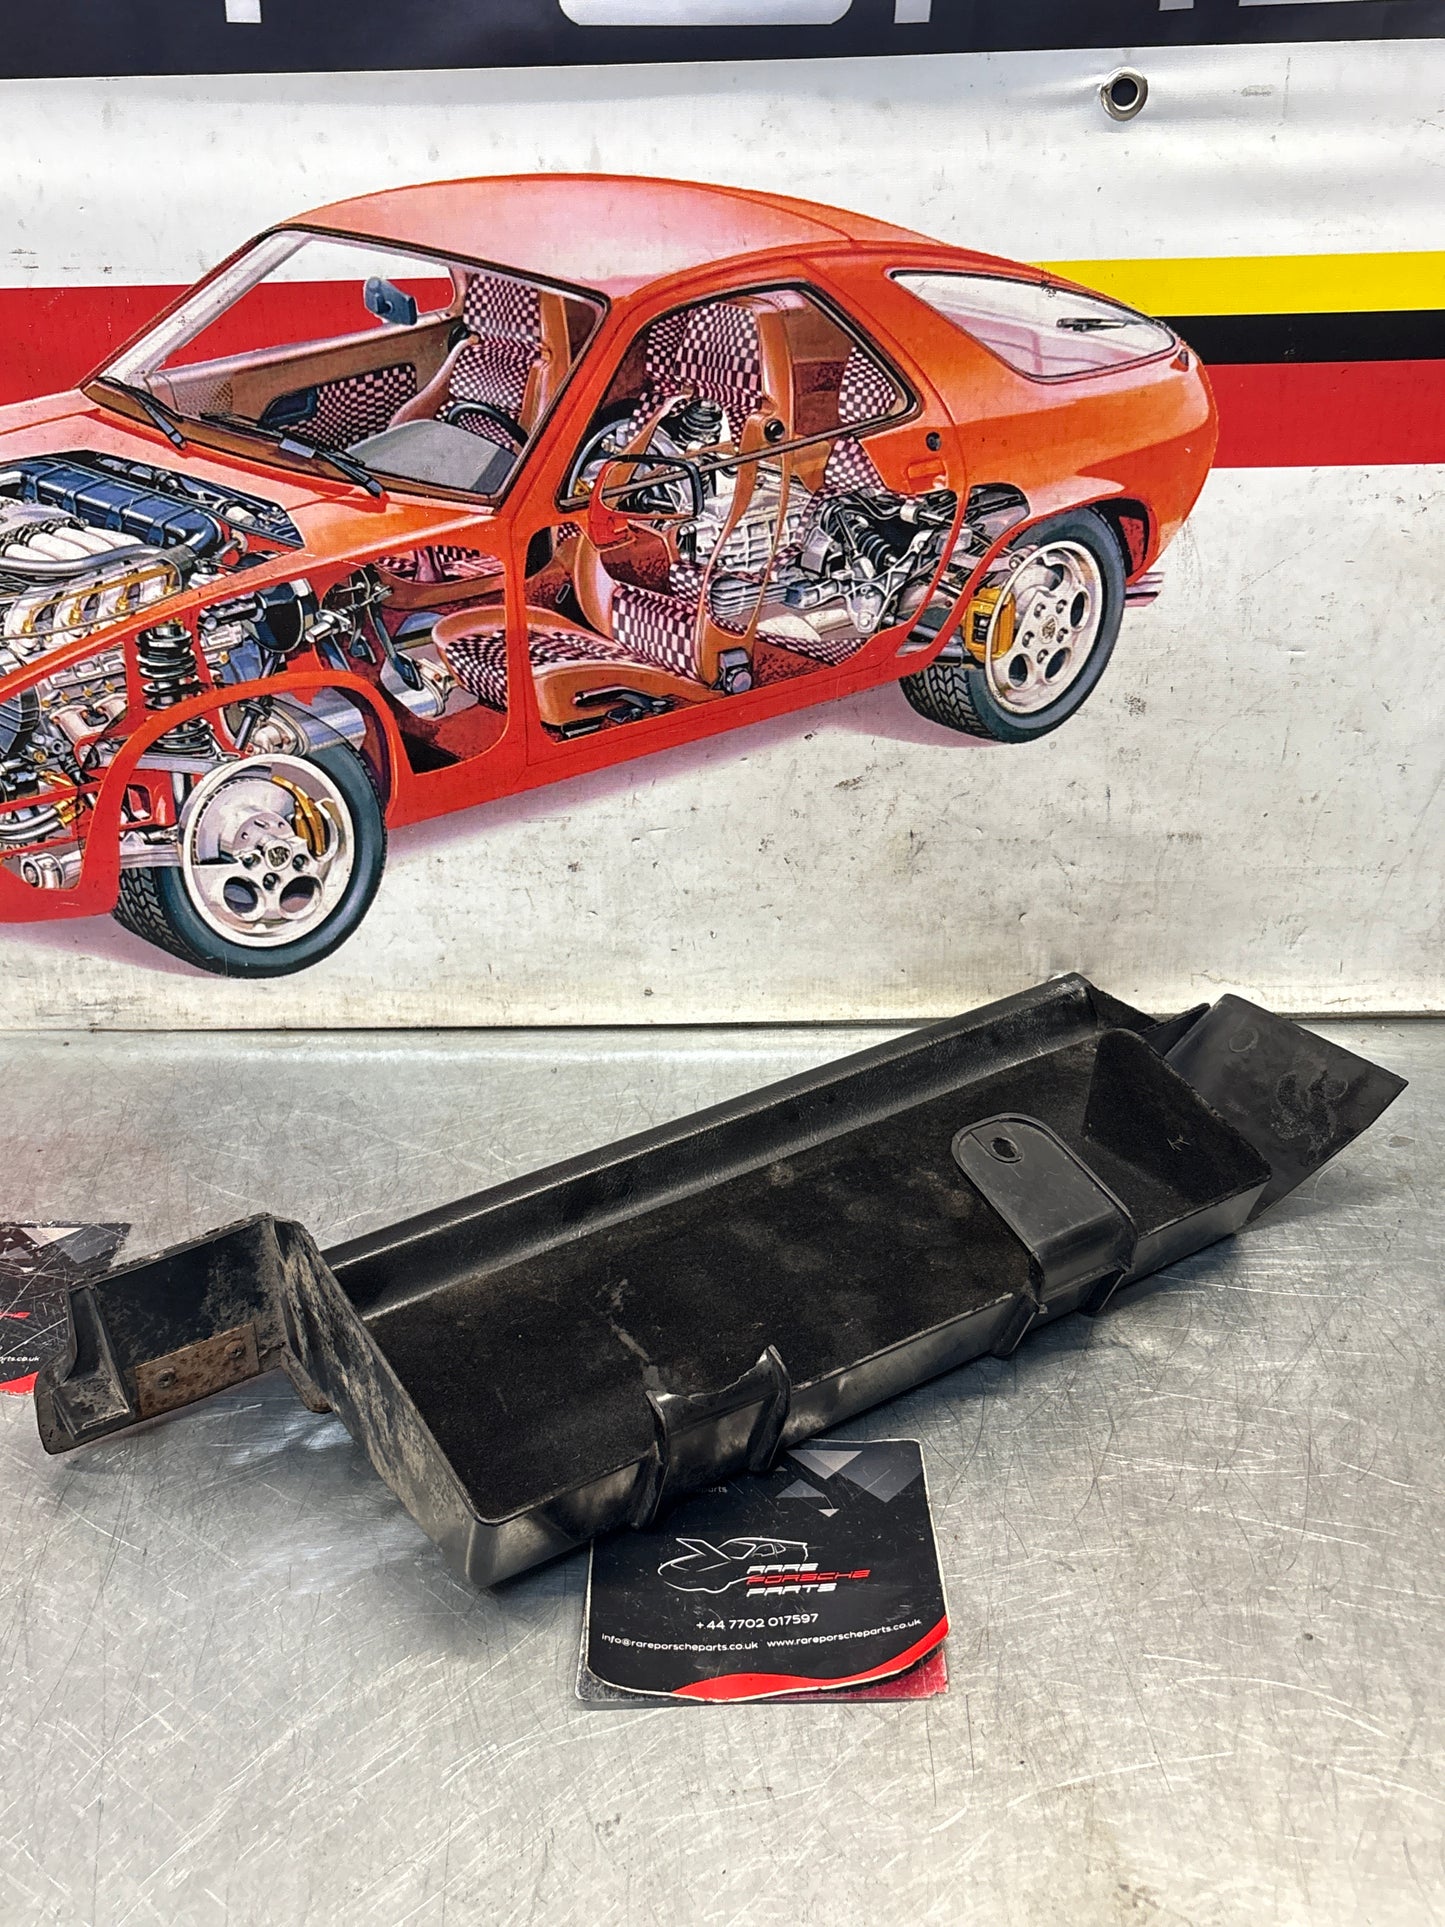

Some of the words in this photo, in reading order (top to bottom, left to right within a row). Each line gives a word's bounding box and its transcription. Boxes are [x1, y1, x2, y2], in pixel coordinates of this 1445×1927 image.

[746, 1563, 819, 1574] RARE
[746, 1569, 871, 1585] PORSCHE
[746, 1583, 837, 1597] PARTS
[728, 1619, 765, 1630] 7702
[767, 1613, 819, 1627] 017597
[601, 1633, 759, 1652] info@rareporscheparts.co.uk
[766, 1618, 922, 1648] www.rareporscheparts.co.uk
